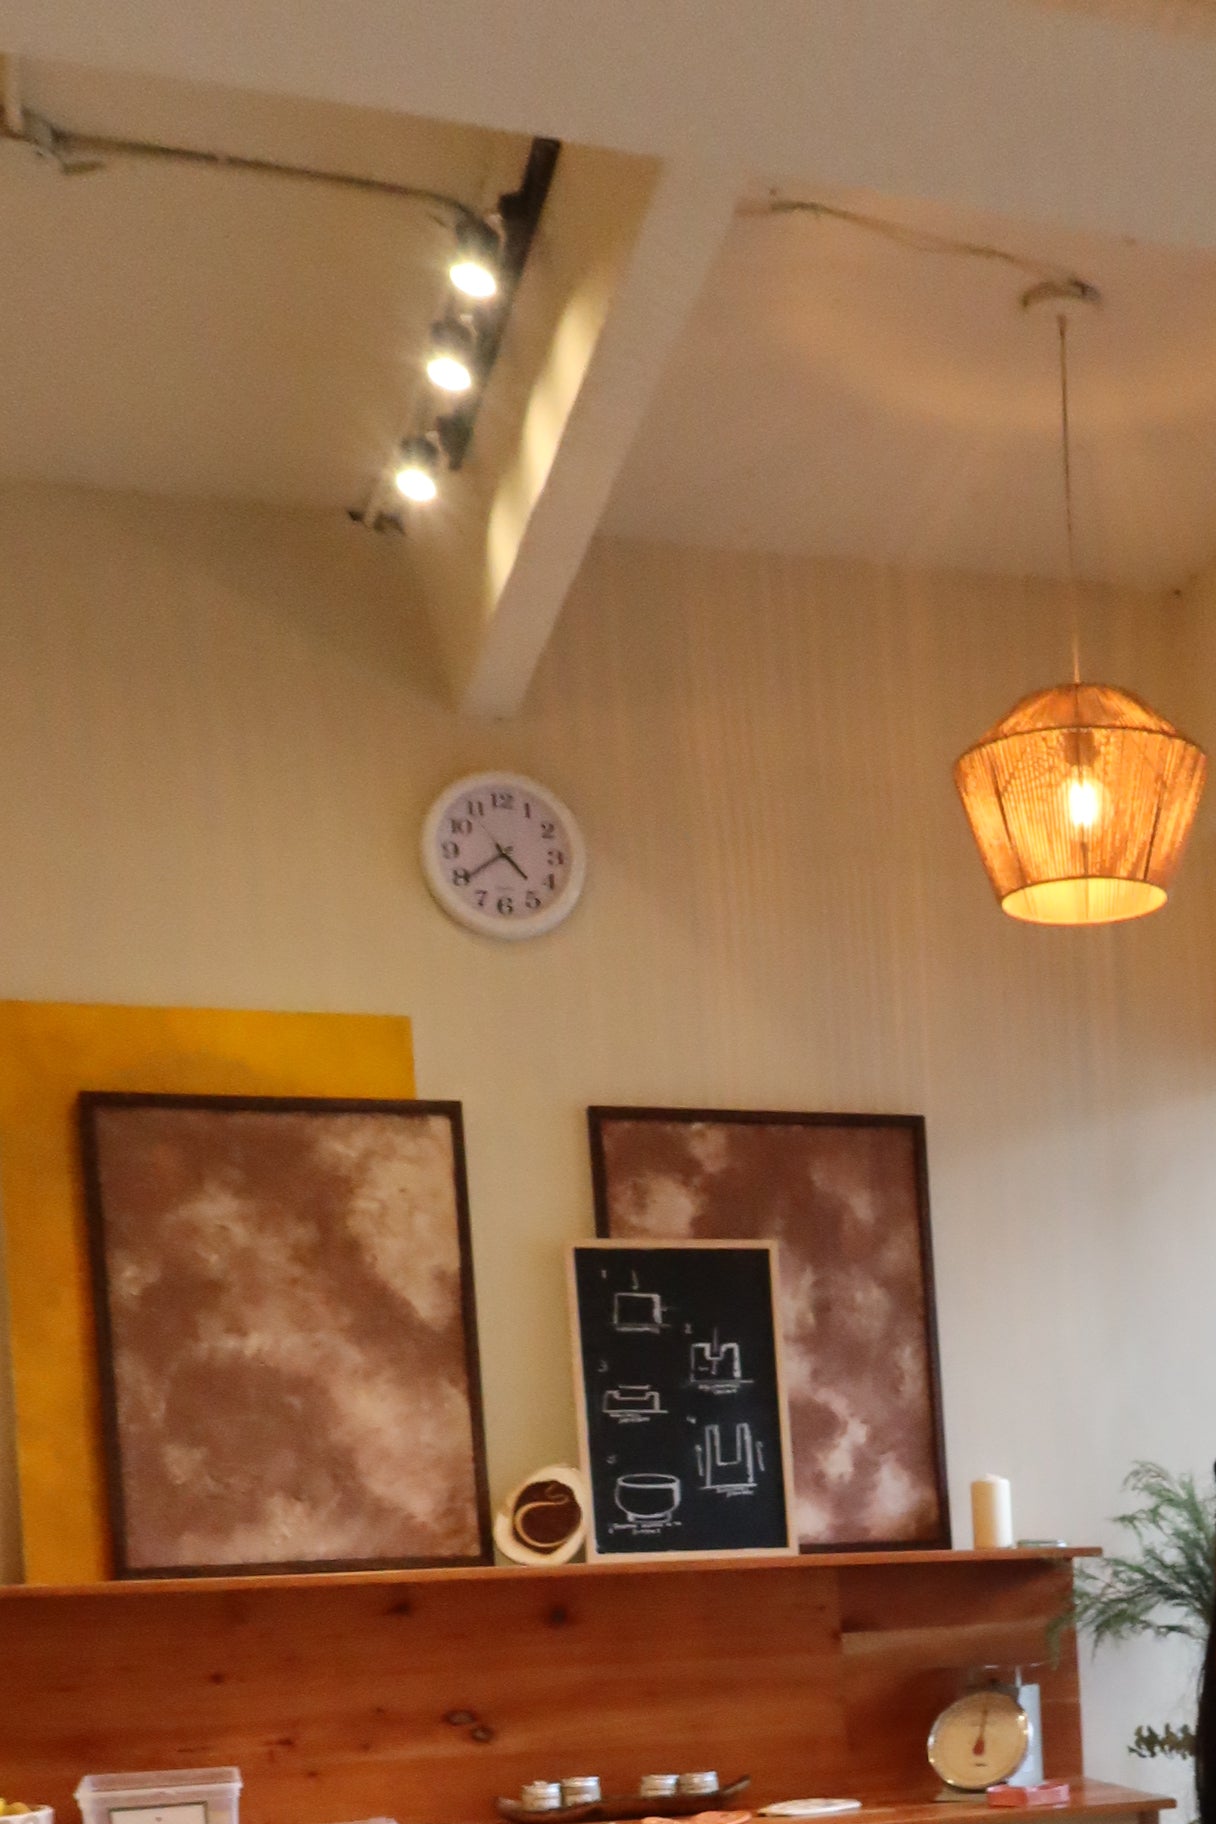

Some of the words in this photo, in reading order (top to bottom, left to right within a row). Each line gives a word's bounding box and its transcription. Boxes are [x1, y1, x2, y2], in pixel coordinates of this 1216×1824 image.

[468, 800, 485, 817] 11
[490, 792, 514, 810] 12
[450, 818, 473, 835] 10
[540, 823, 555, 840] 2
[442, 841, 460, 859] 9
[547, 850, 565, 866] 3
[452, 867, 471, 887] 8
[543, 872, 556, 890] 4
[474, 889, 489, 908] 7
[496, 896, 514, 916] 6
[524, 890, 543, 910] 5
